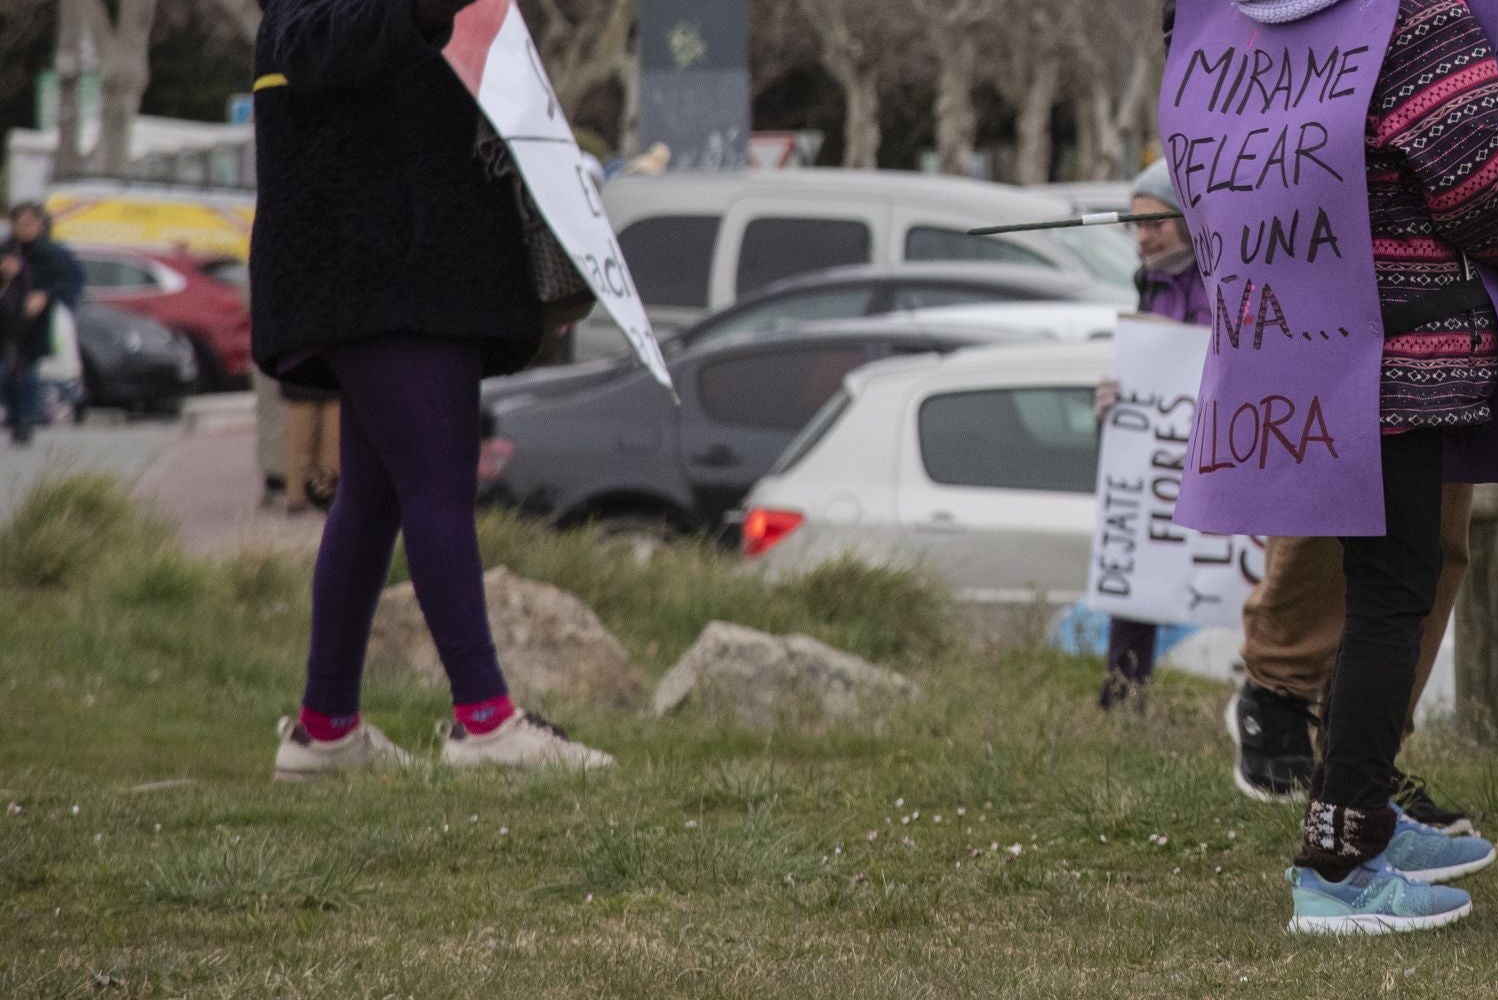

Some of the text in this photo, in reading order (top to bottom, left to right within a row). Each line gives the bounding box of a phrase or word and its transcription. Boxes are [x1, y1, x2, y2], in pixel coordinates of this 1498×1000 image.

[1167, 121, 1344, 209] PELEAR
[1240, 206, 1342, 266] UNA
[1098, 390, 1155, 596] DEJATE DE
